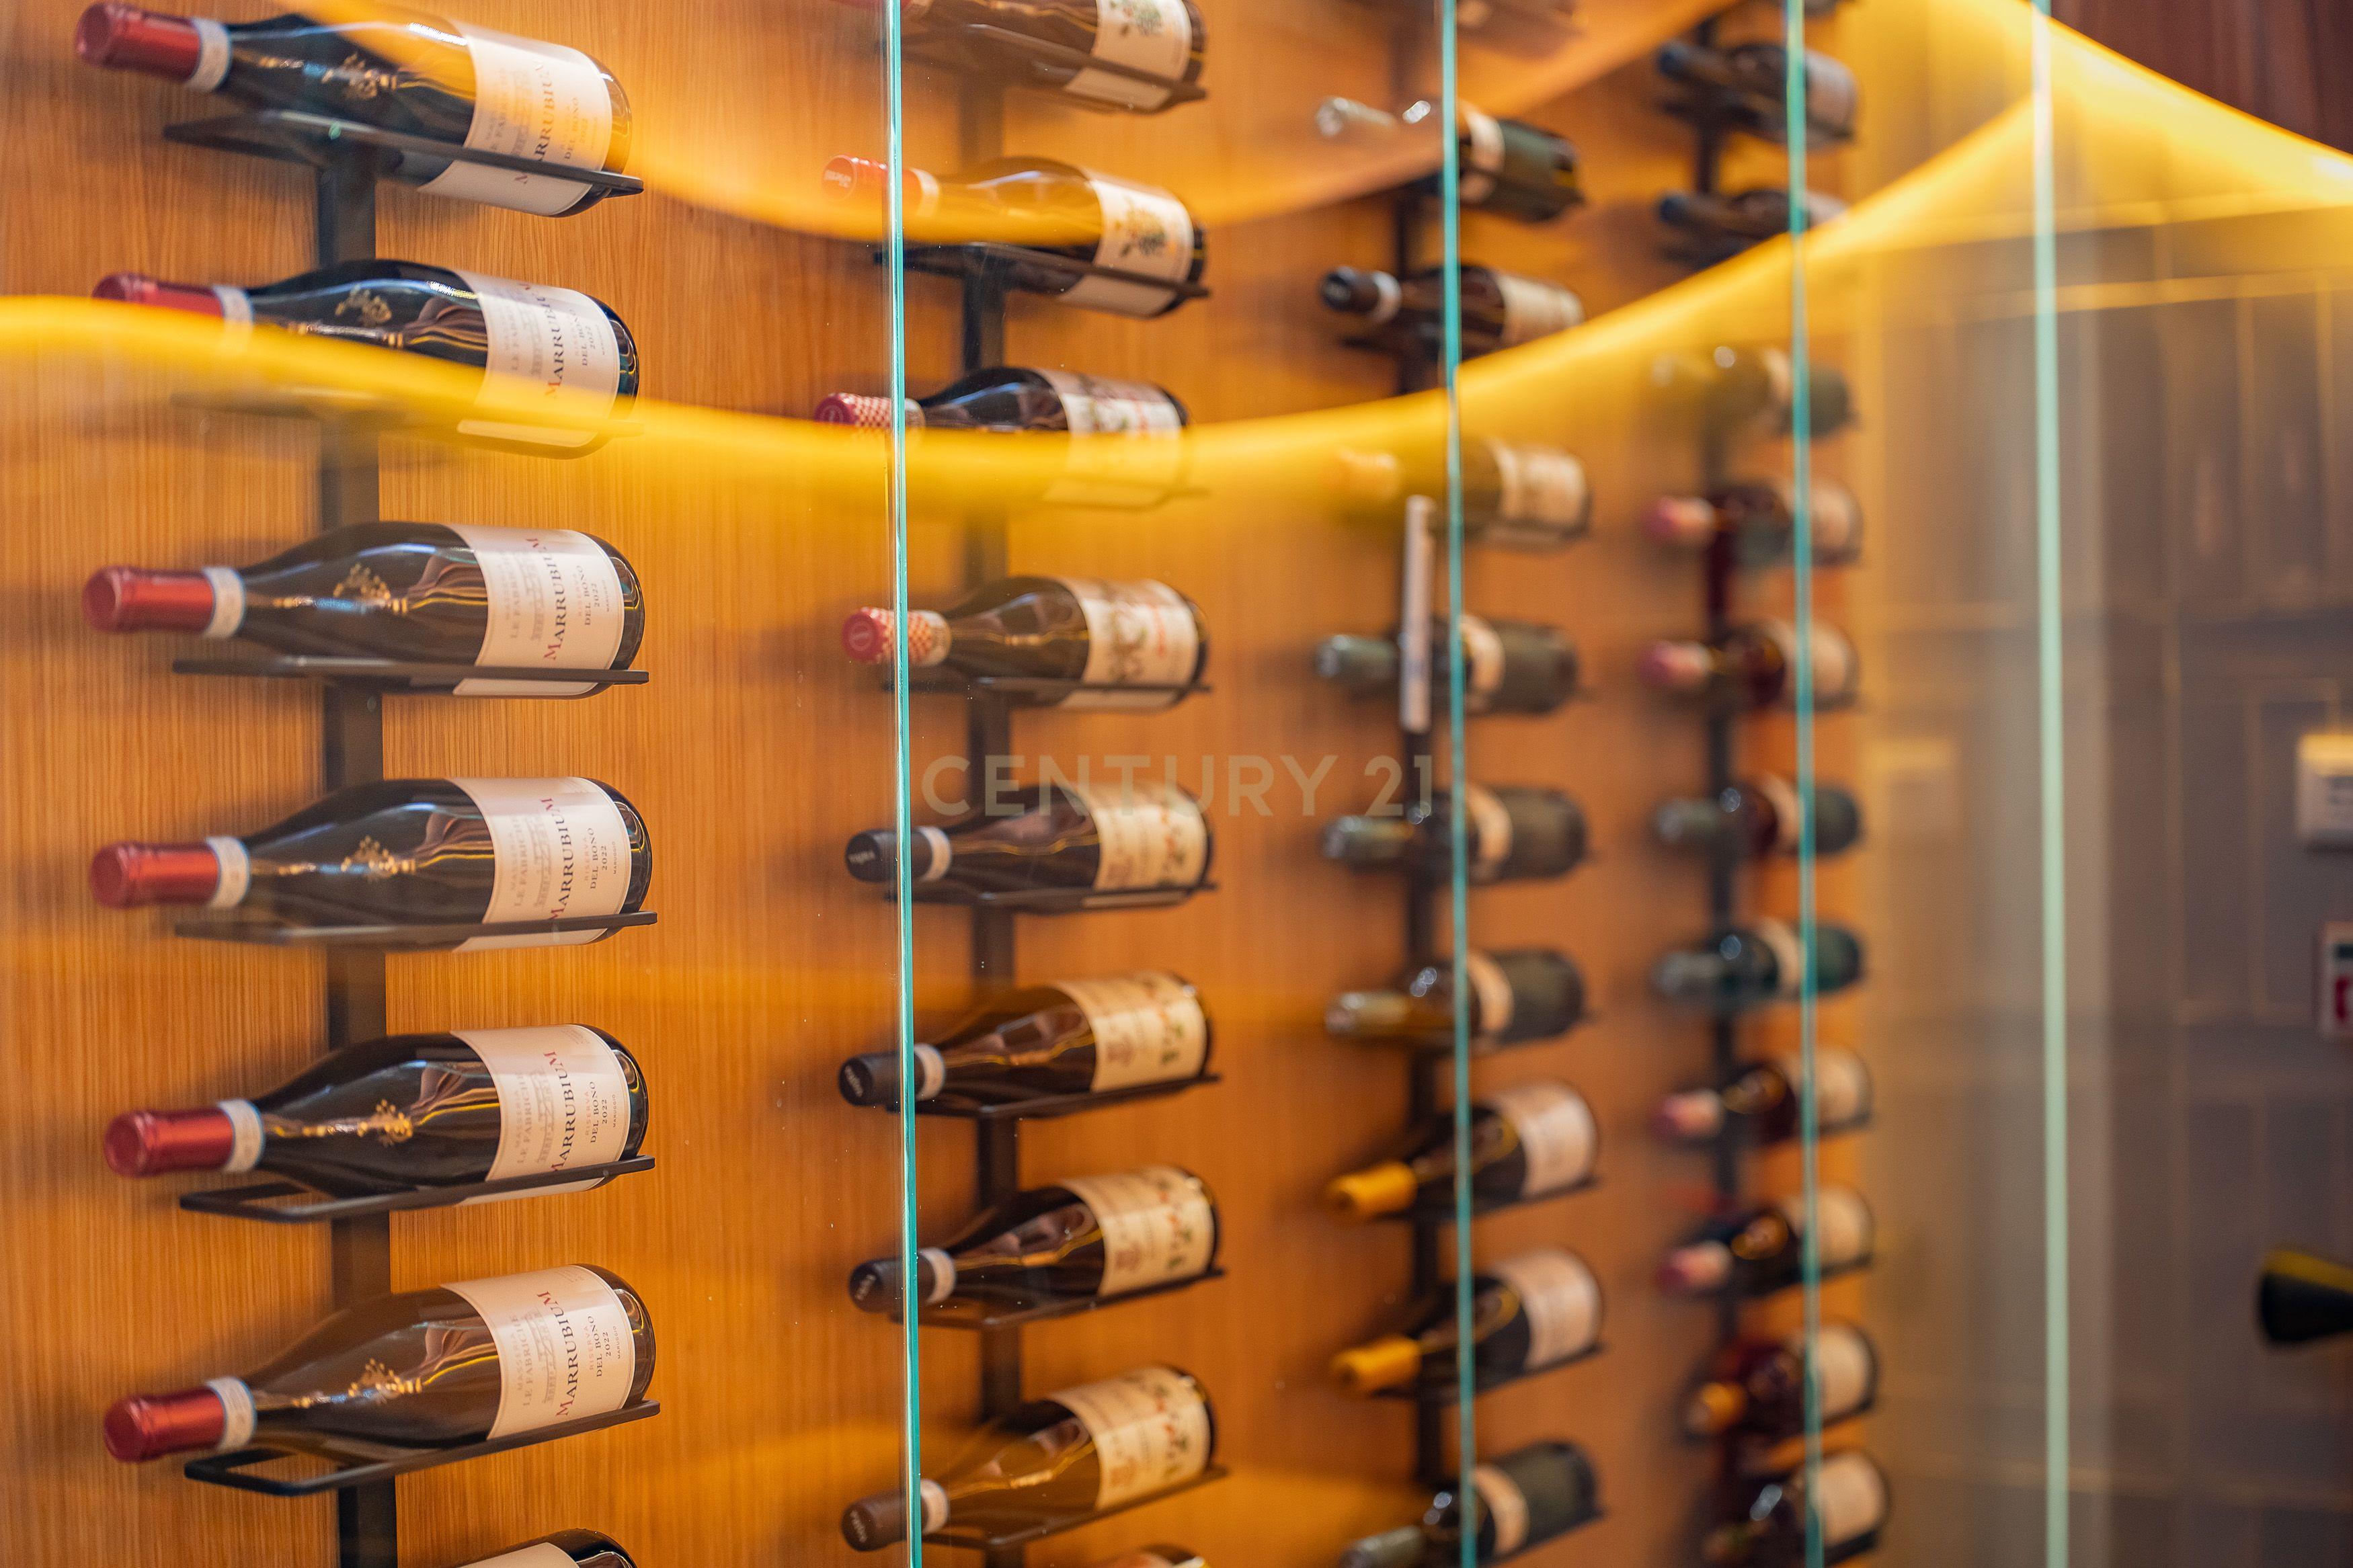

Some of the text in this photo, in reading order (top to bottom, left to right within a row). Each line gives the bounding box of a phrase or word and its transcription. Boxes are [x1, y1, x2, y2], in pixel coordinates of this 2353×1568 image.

[592, 583, 600, 608] 2022
[583, 602, 592, 625] DEL
[588, 828, 598, 889] DEL BONO
[589, 1081, 598, 1143] DEL BONO
[584, 1325, 594, 1370] RISERVA
[588, 1316, 601, 1348] BONO
[602, 1331, 611, 1357] 2022
[612, 1325, 621, 1360] MARUGGIO
[536, 1290, 579, 1416] MARRUBIUM
